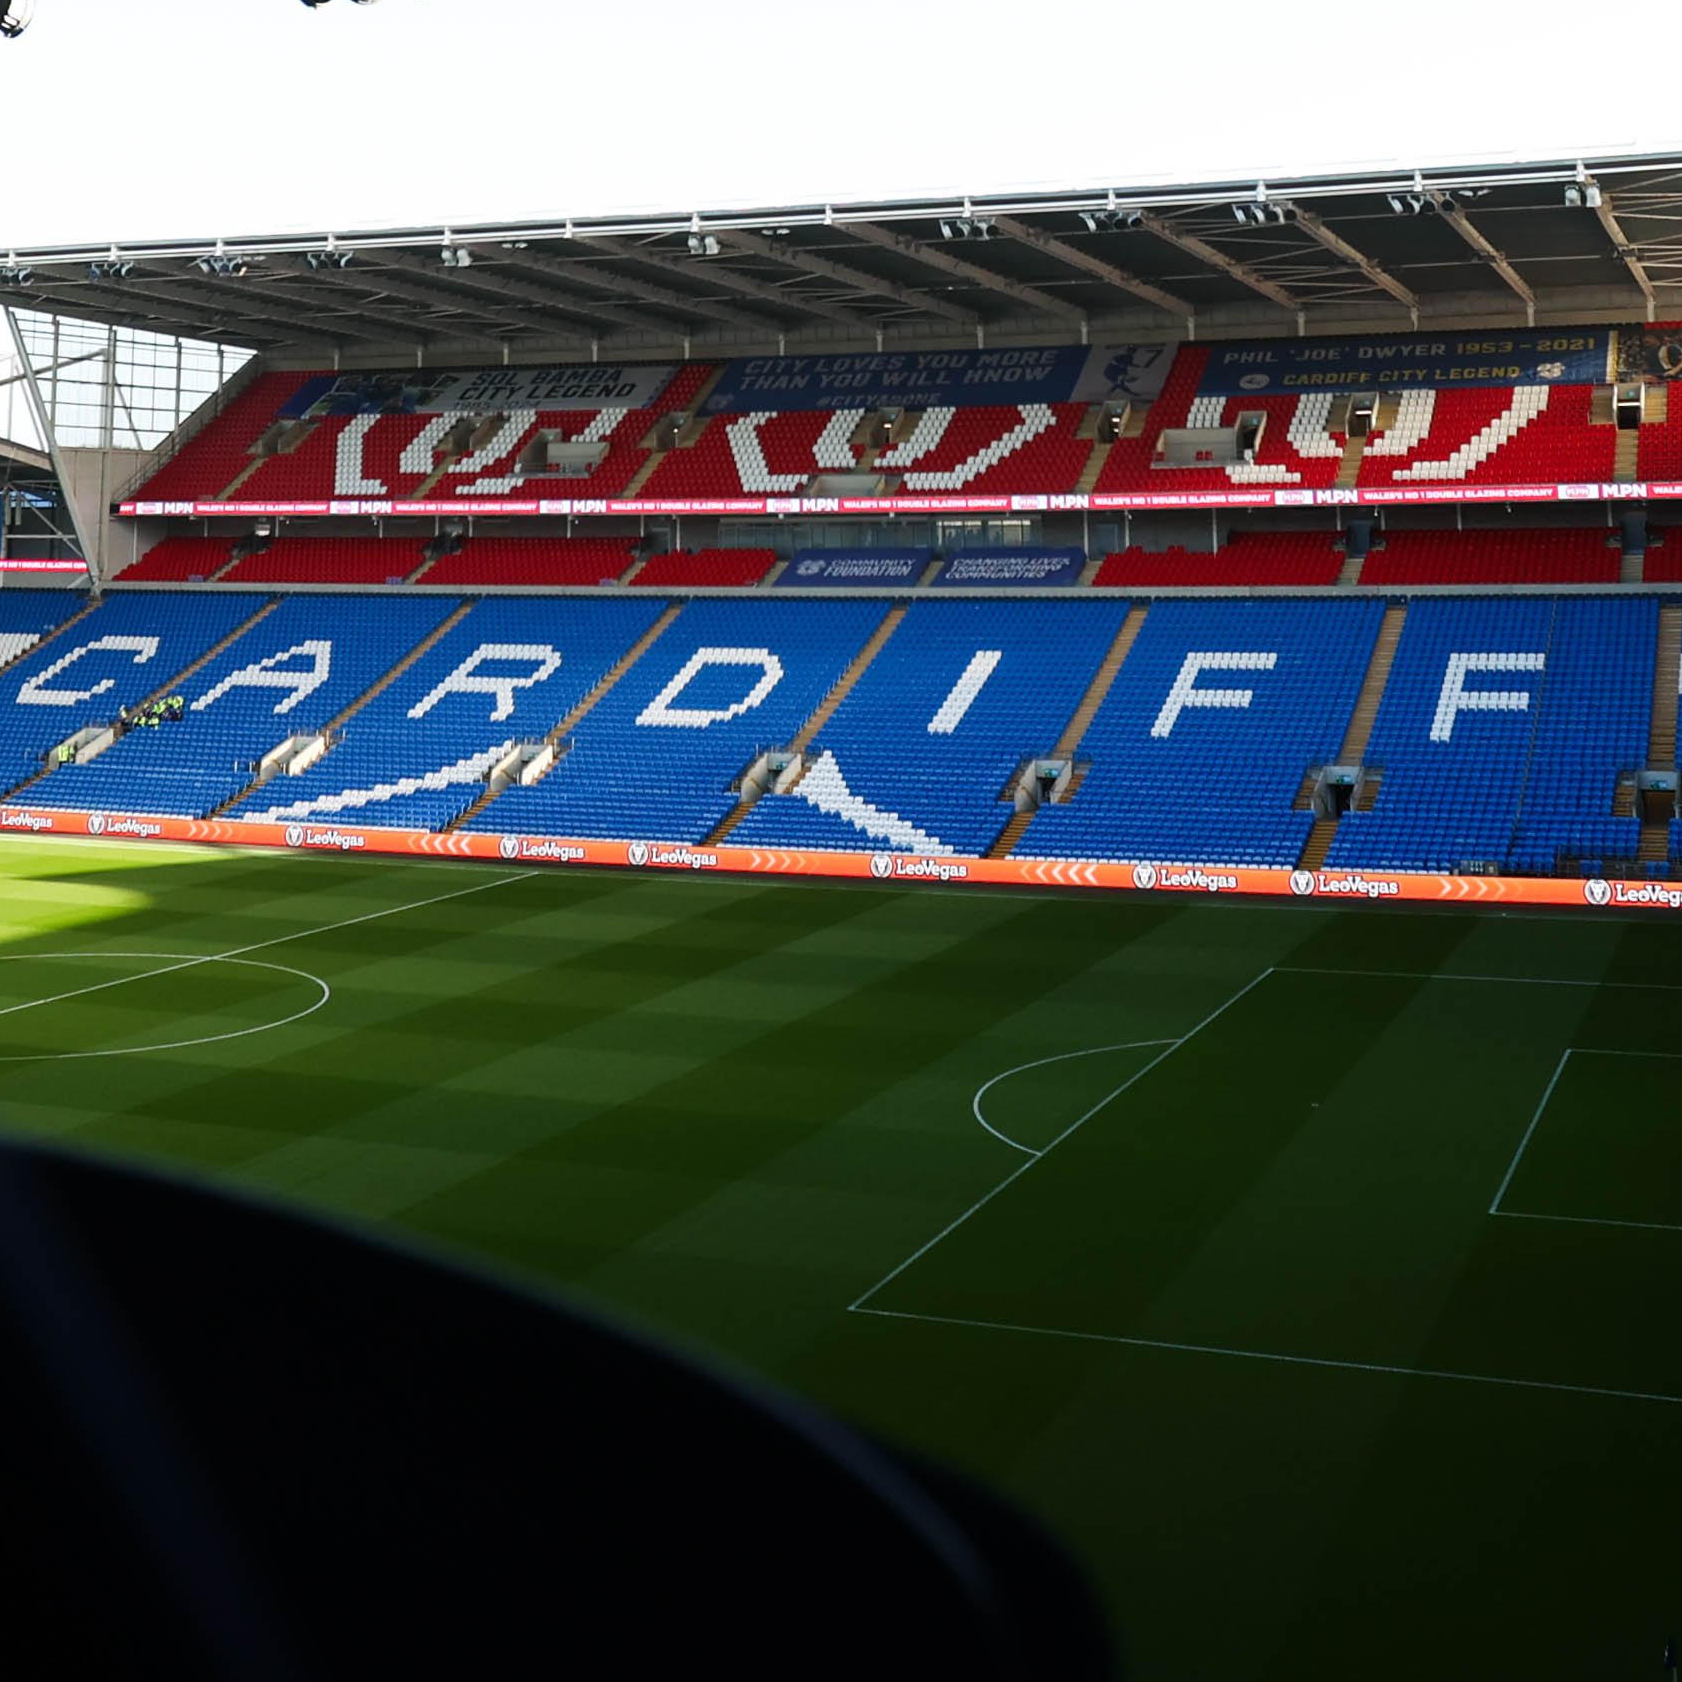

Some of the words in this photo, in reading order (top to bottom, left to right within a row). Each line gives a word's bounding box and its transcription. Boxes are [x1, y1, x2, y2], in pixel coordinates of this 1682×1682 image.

[1223, 348, 1278, 364] PHIL
[1358, 343, 1447, 359] DWYER
[1456, 341, 1514, 355] 1953
[1536, 338, 1597, 353] 2021
[745, 359, 806, 375] CITY
[814, 356, 906, 372] LOVES
[917, 353, 969, 369] YOU
[978, 349, 1058, 367] MORE
[471, 371, 519, 386] SOL
[529, 368, 623, 385] BAMBA
[739, 375, 810, 391] THAN
[820, 372, 873, 388] YOU
[881, 369, 952, 386] WILL
[1282, 371, 1371, 387] CARDIFF
[1379, 368, 1427, 383] CITY
[1434, 365, 1522, 381] LEGEND
[459, 386, 525, 401] CITY
[526, 383, 637, 399] LEGEND
[823, 566, 912, 577] FOUNDATION
[945, 571, 1046, 580] COMMUNITIES
[1, 811, 53, 831] LeoVegas
[106, 818, 161, 838] LeoVegas
[305, 829, 365, 850] LeoVegas
[521, 840, 585, 861] LeoVegas
[651, 848, 718, 869] LeoVegas
[895, 857, 968, 881] LeoVegas
[1159, 869, 1238, 892] LeoVegas
[1318, 875, 1399, 898] LeoVegas
